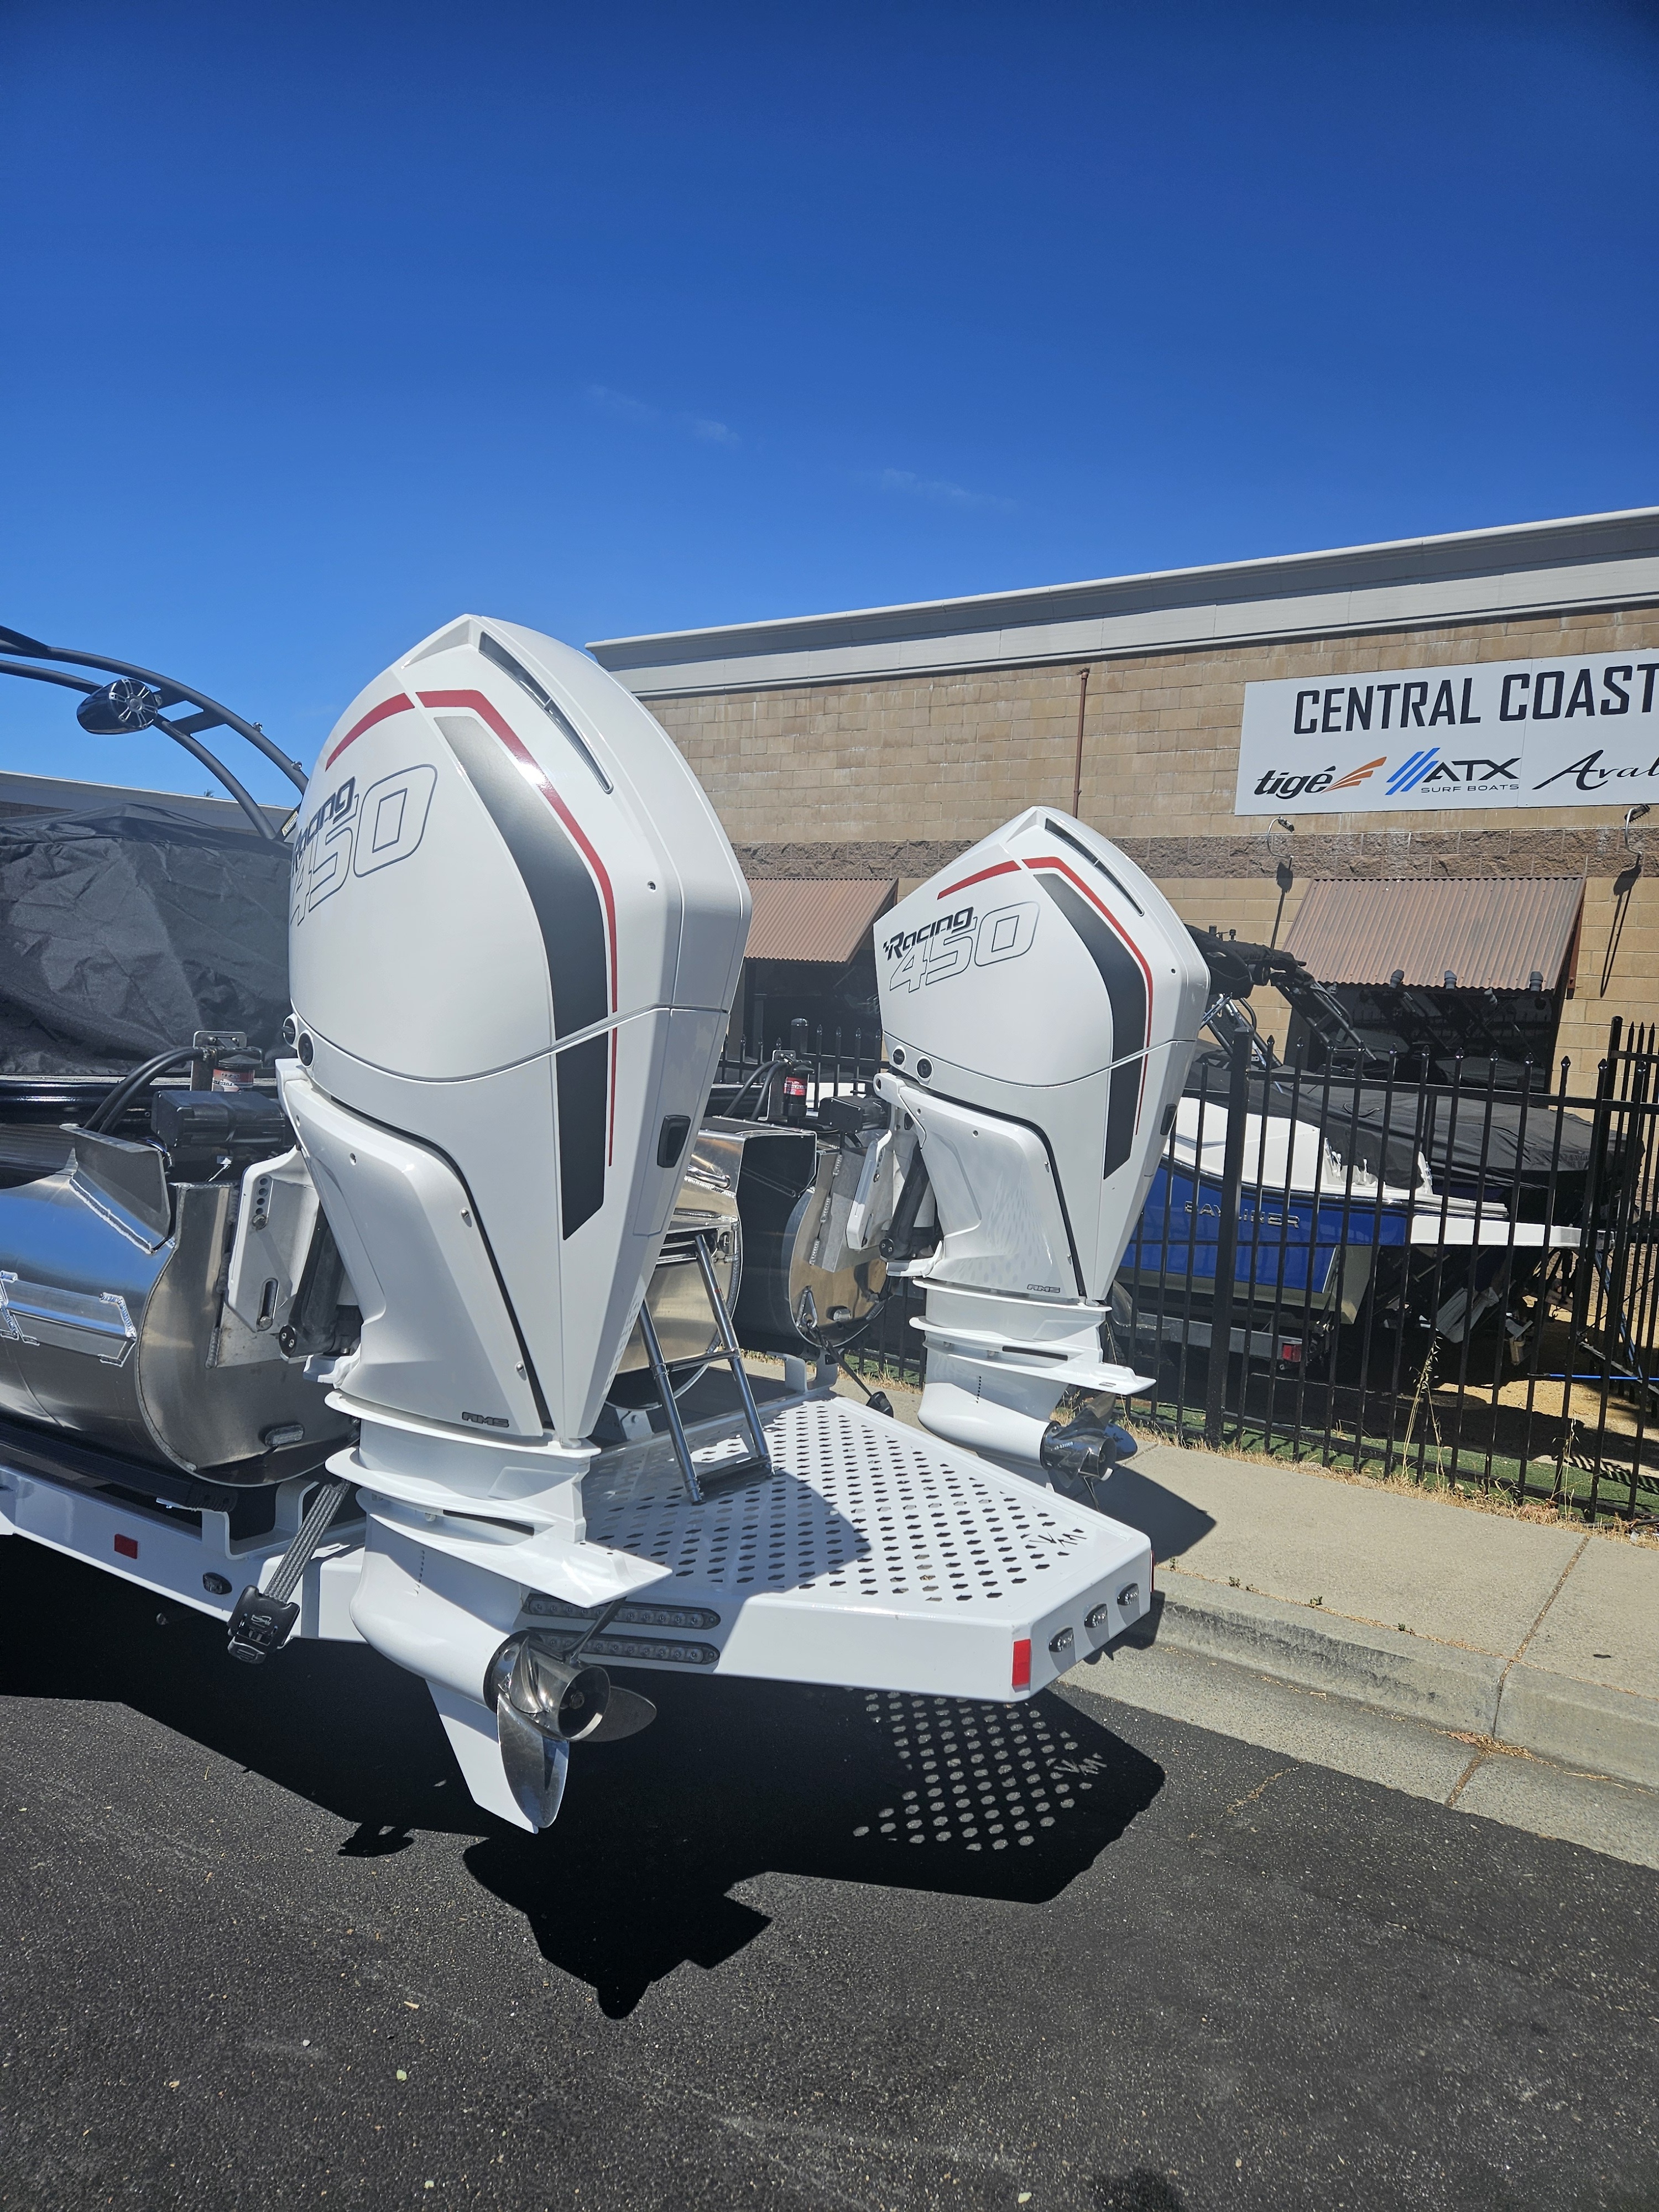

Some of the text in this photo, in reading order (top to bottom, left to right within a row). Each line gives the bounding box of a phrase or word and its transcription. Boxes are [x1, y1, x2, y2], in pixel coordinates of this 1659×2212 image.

[1294, 663, 1659, 734] CENTRAL COAST
[1254, 765, 1336, 800] tigé
[1422, 757, 1522, 783] ATX
[883, 906, 974, 961] Racing
[889, 900, 1041, 993] 450
[1027, 1284, 1061, 1293] AMS
[461, 1411, 509, 1428] AMS
